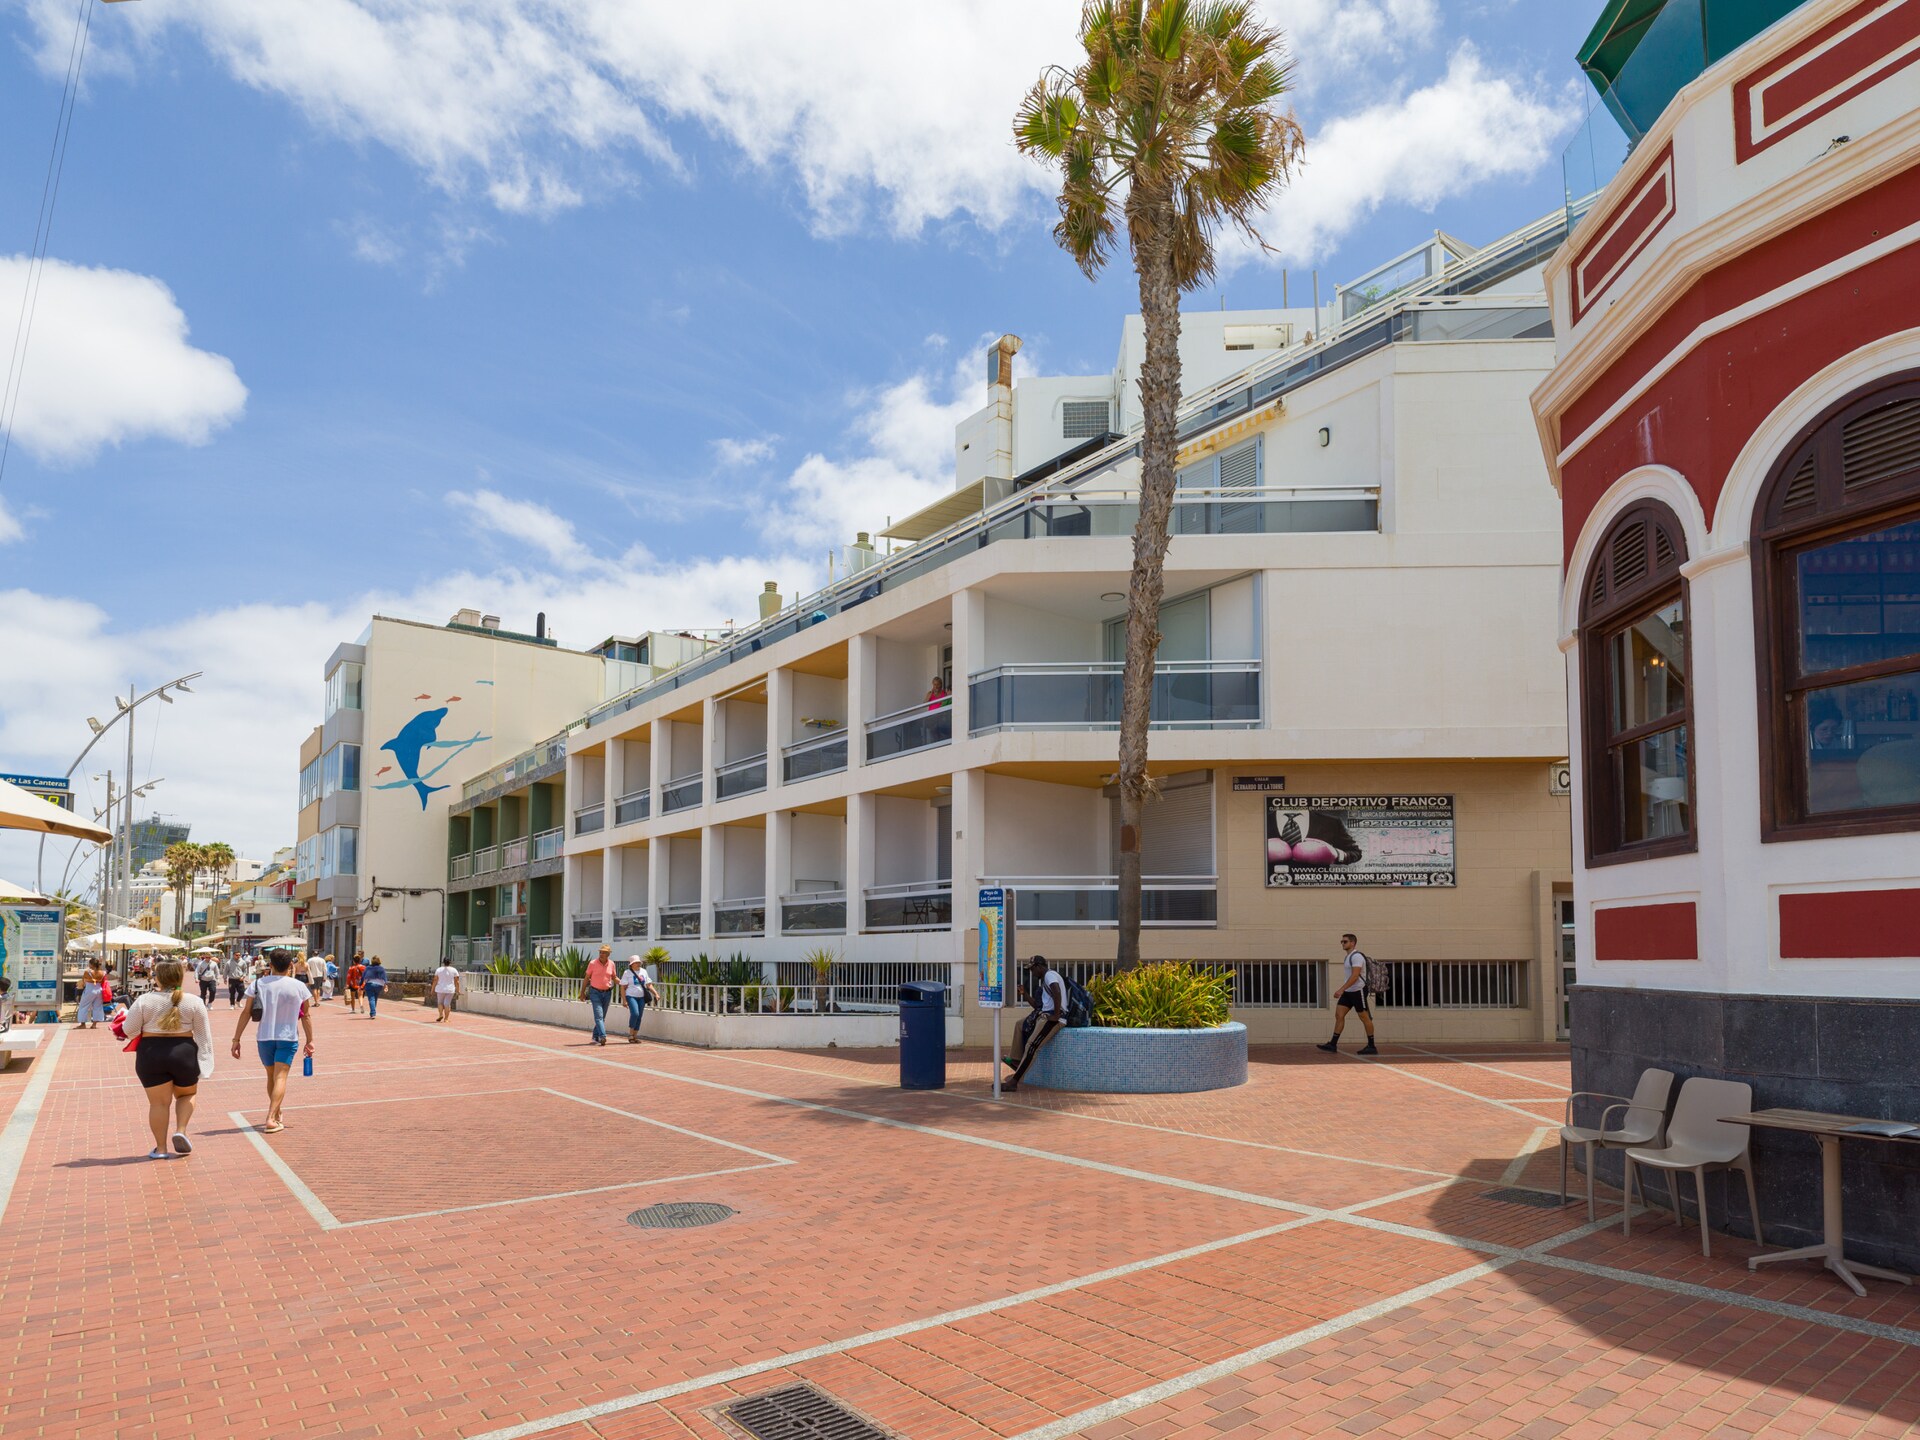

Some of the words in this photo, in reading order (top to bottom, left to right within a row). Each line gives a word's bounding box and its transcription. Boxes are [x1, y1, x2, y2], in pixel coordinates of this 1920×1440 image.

[33, 779, 67, 788] Canteras
[1272, 797, 1308, 807] CLUB
[1311, 797, 1388, 807] DEPORTIVO
[1391, 797, 1448, 806] FRANCO
[1294, 873, 1322, 881] BOXEO
[1322, 873, 1347, 881] PARA
[1347, 873, 1375, 881] TODOS
[1376, 873, 1392, 881] LOS
